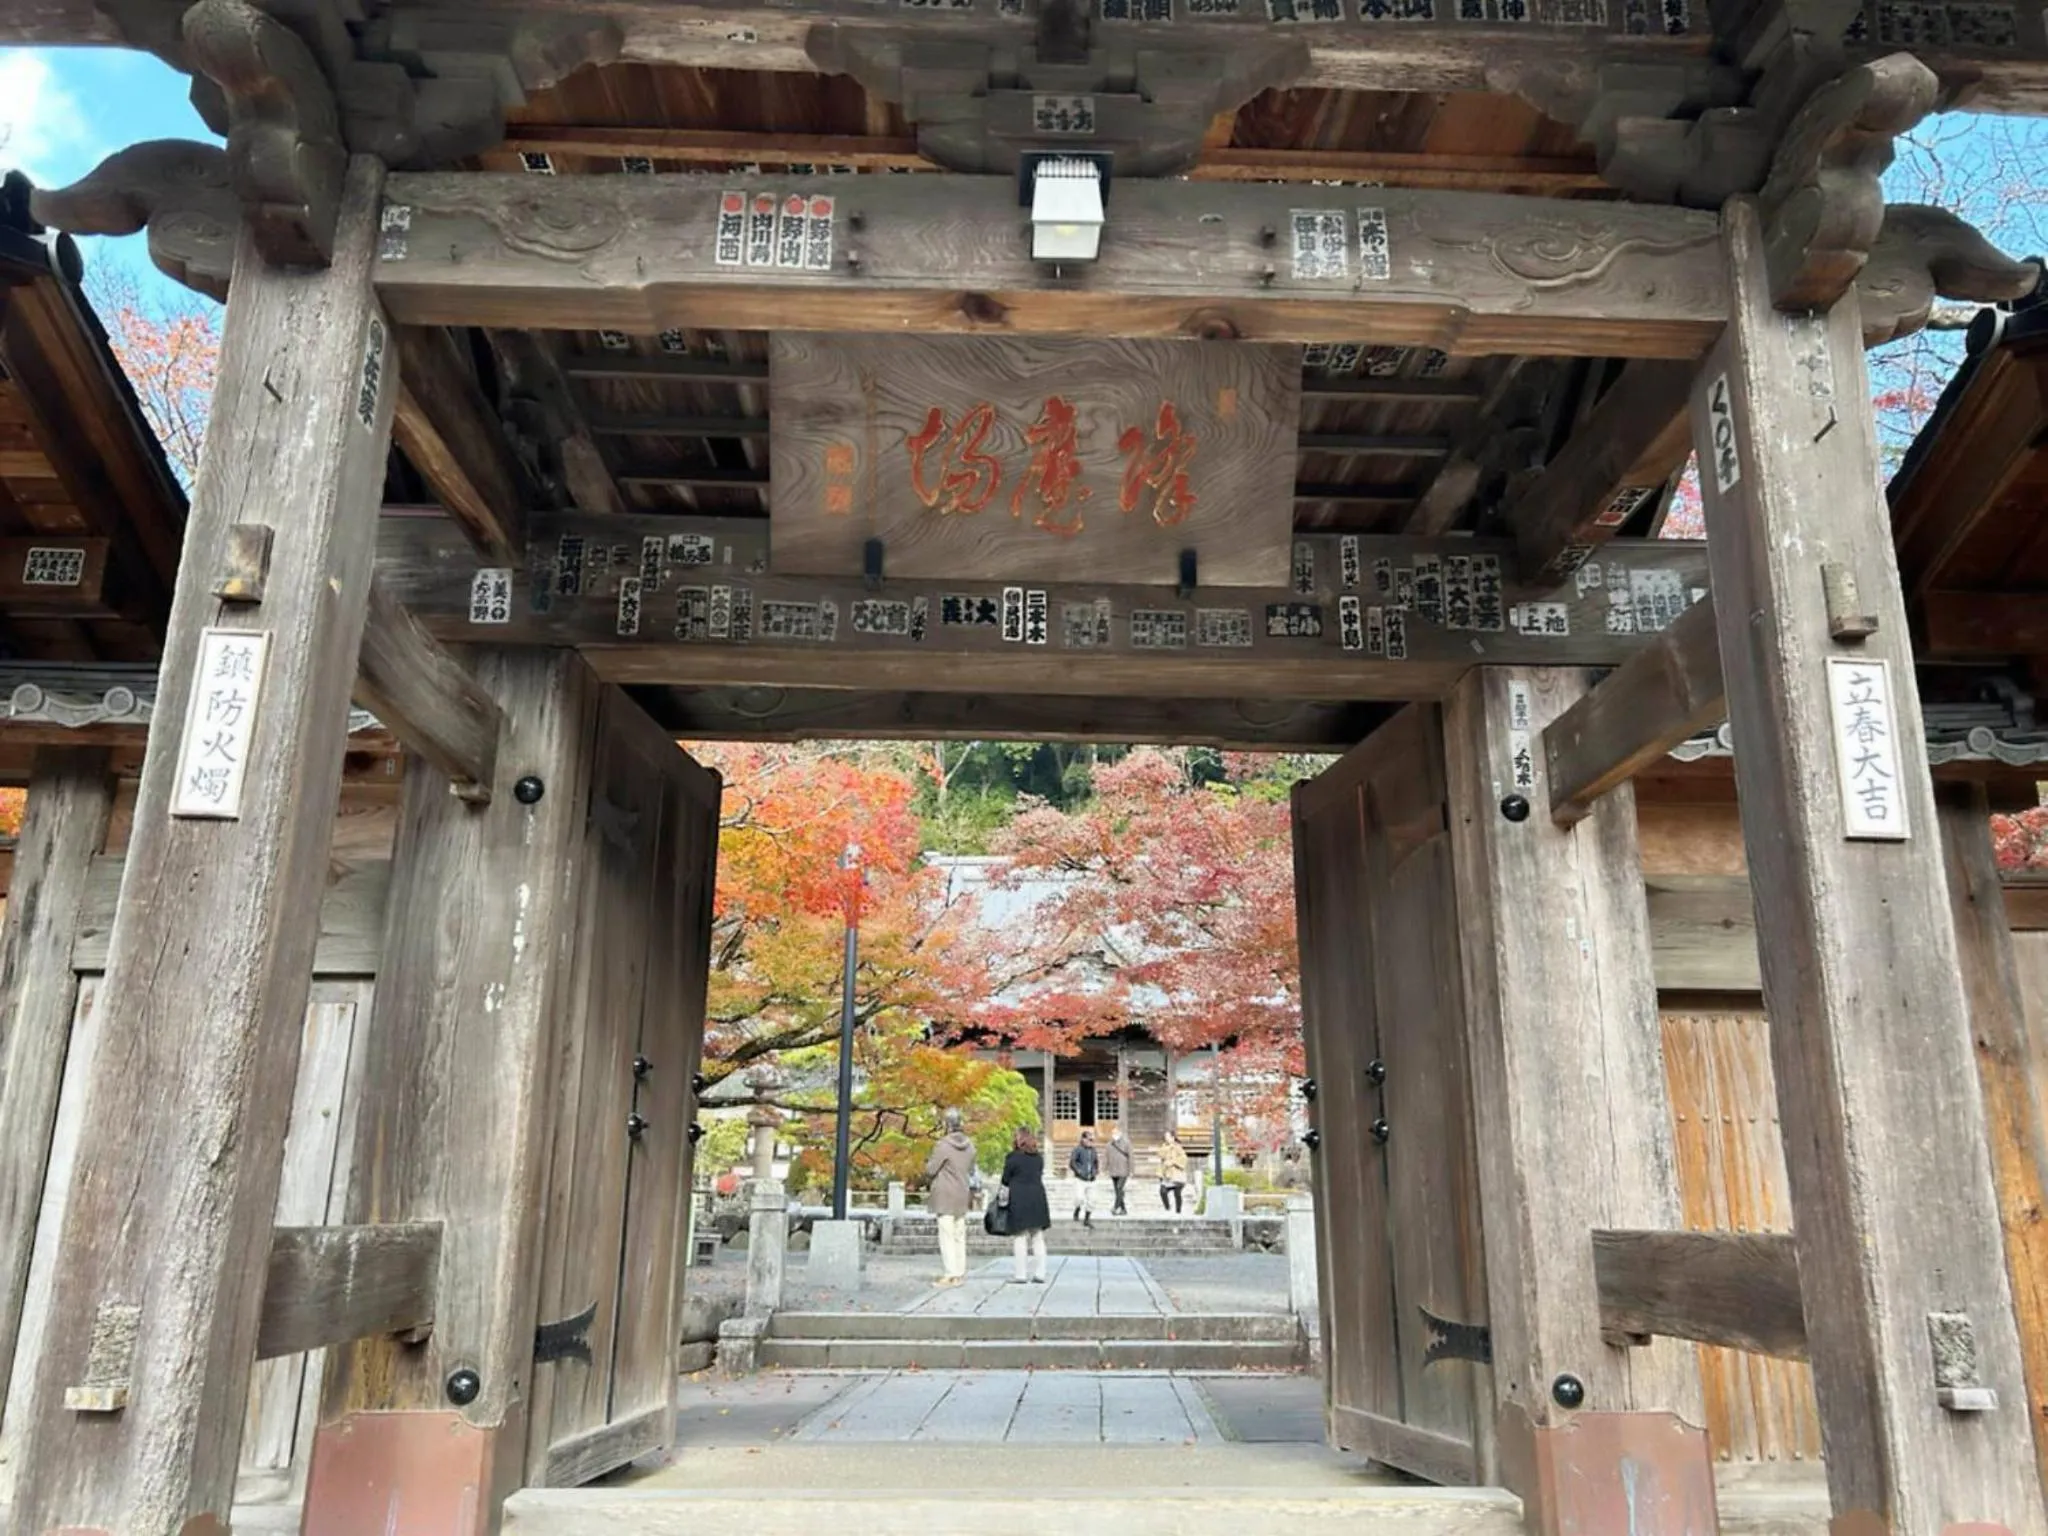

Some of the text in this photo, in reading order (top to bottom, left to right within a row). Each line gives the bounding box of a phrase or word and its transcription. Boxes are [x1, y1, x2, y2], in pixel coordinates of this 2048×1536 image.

[188, 644, 253, 804] 鎮防火燭
[1843, 671, 1893, 820] 立春大吉
